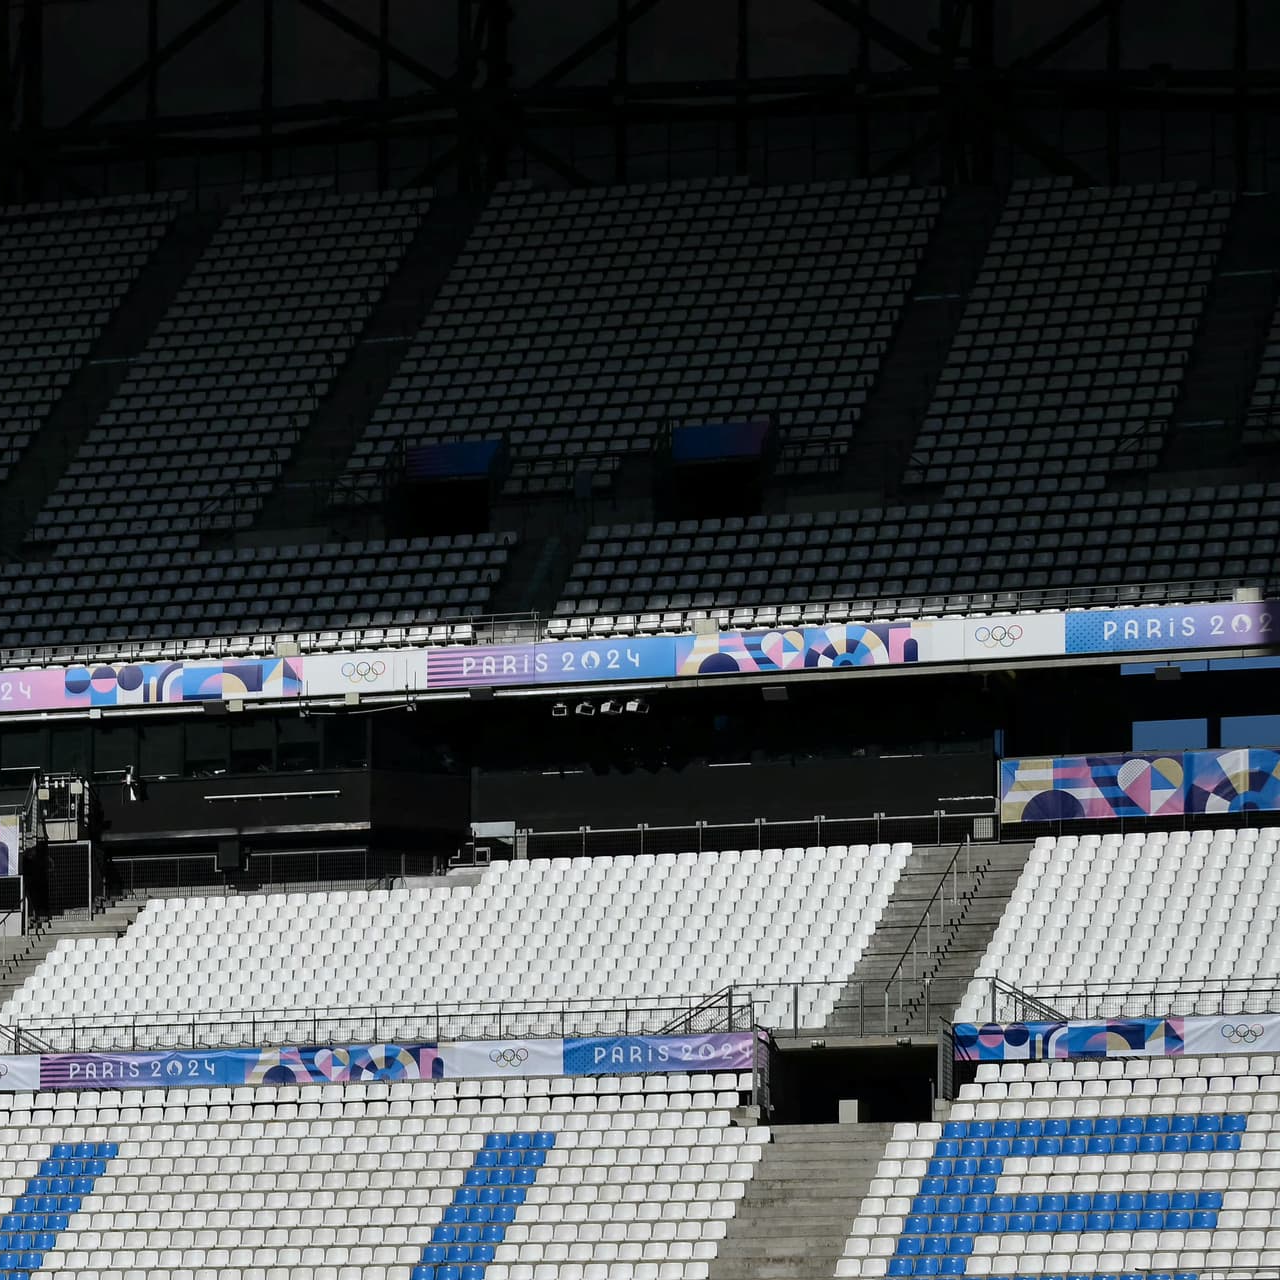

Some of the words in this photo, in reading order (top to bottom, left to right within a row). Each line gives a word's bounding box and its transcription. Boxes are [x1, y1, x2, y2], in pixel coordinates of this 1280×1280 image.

[1103, 616, 1195, 641] PARIS
[462, 652, 548, 675] PARIS
[561, 649, 640, 671] 2024
[594, 1045, 670, 1064] PARIS
[681, 1042, 752, 1061] 2024
[69, 1061, 140, 1079] PARIS
[150, 1058, 215, 1077] 2024
